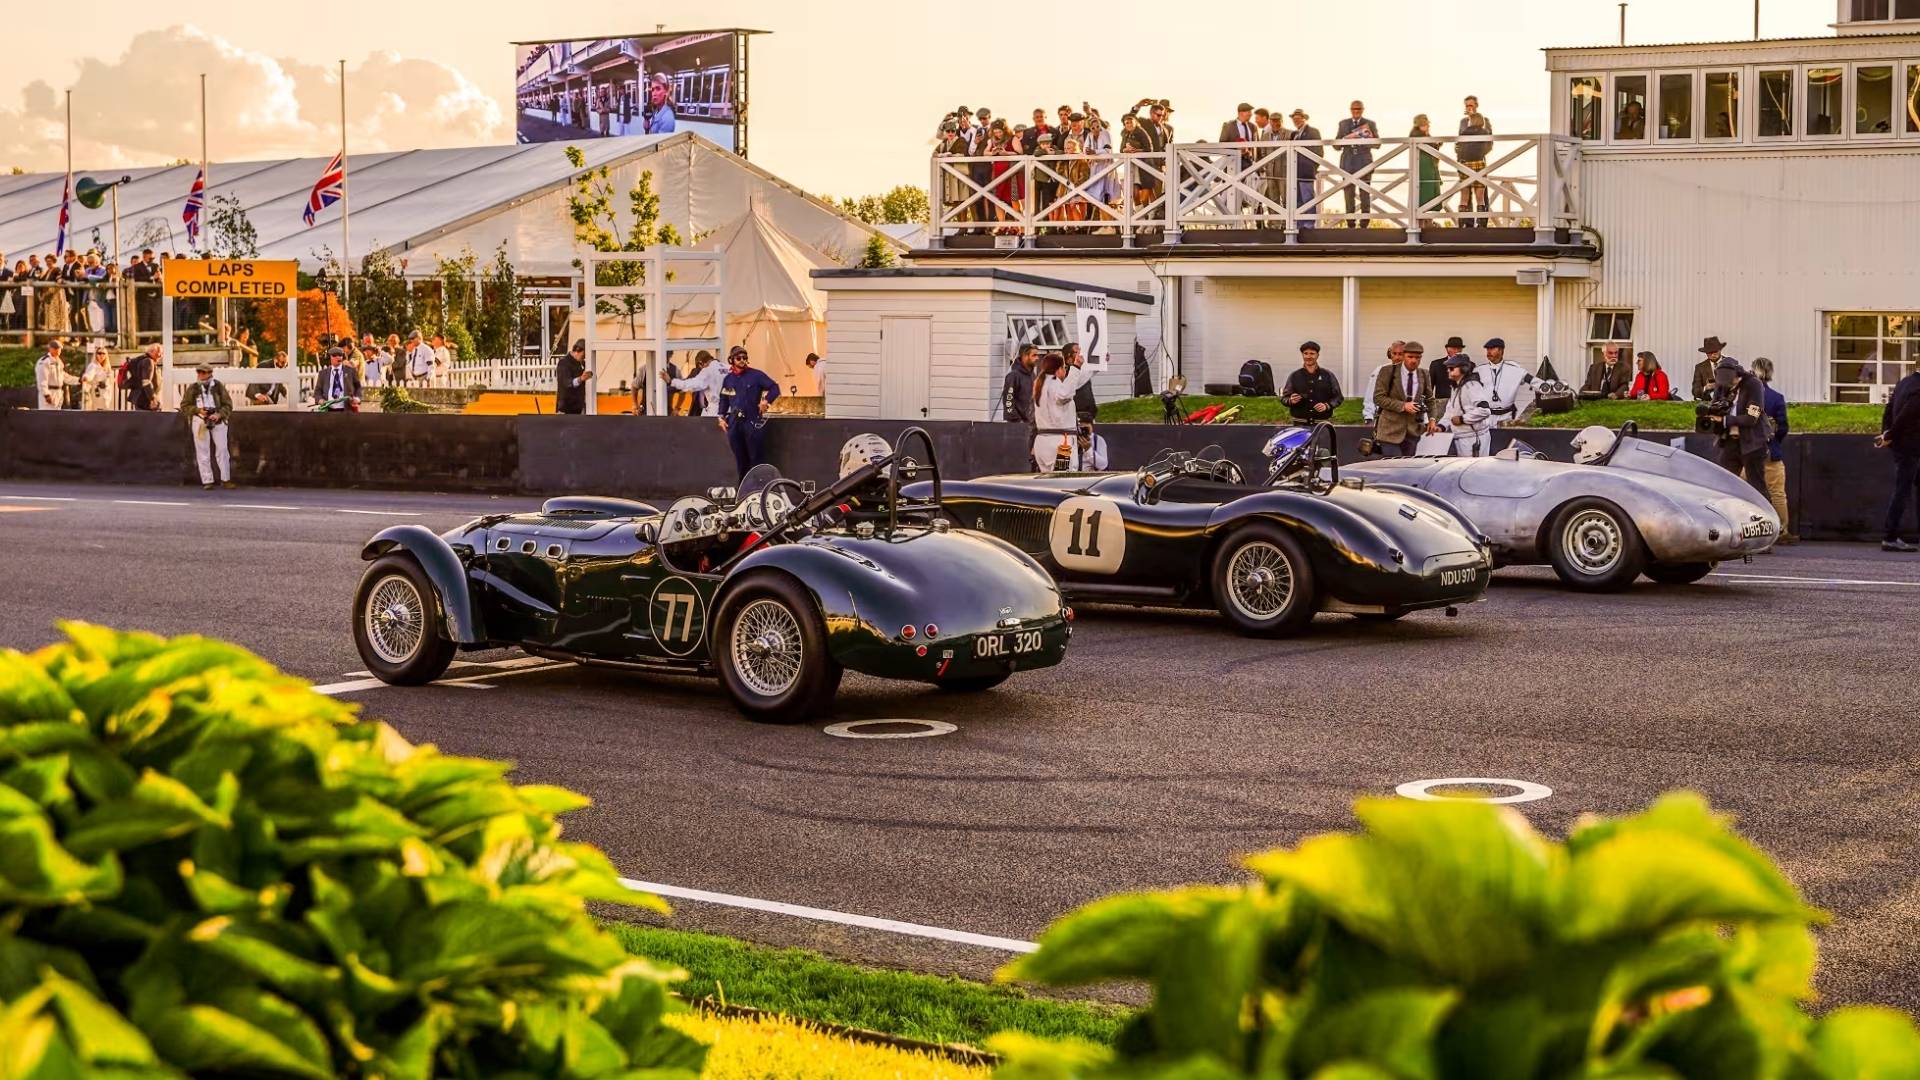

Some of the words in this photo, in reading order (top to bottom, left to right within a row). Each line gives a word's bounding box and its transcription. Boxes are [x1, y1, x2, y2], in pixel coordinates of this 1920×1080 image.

[208, 262, 254, 277] LAPS
[176, 280, 286, 295] COMPLETED
[1076, 295, 1106, 311] MINUTES
[1086, 314, 1100, 364] 2
[1067, 507, 1102, 558] 11
[1441, 569, 1460, 586] NDU
[1461, 567, 1476, 583] 970
[658, 592, 695, 642] 77
[977, 635, 1010, 657] ORL
[1013, 631, 1042, 653] 320
